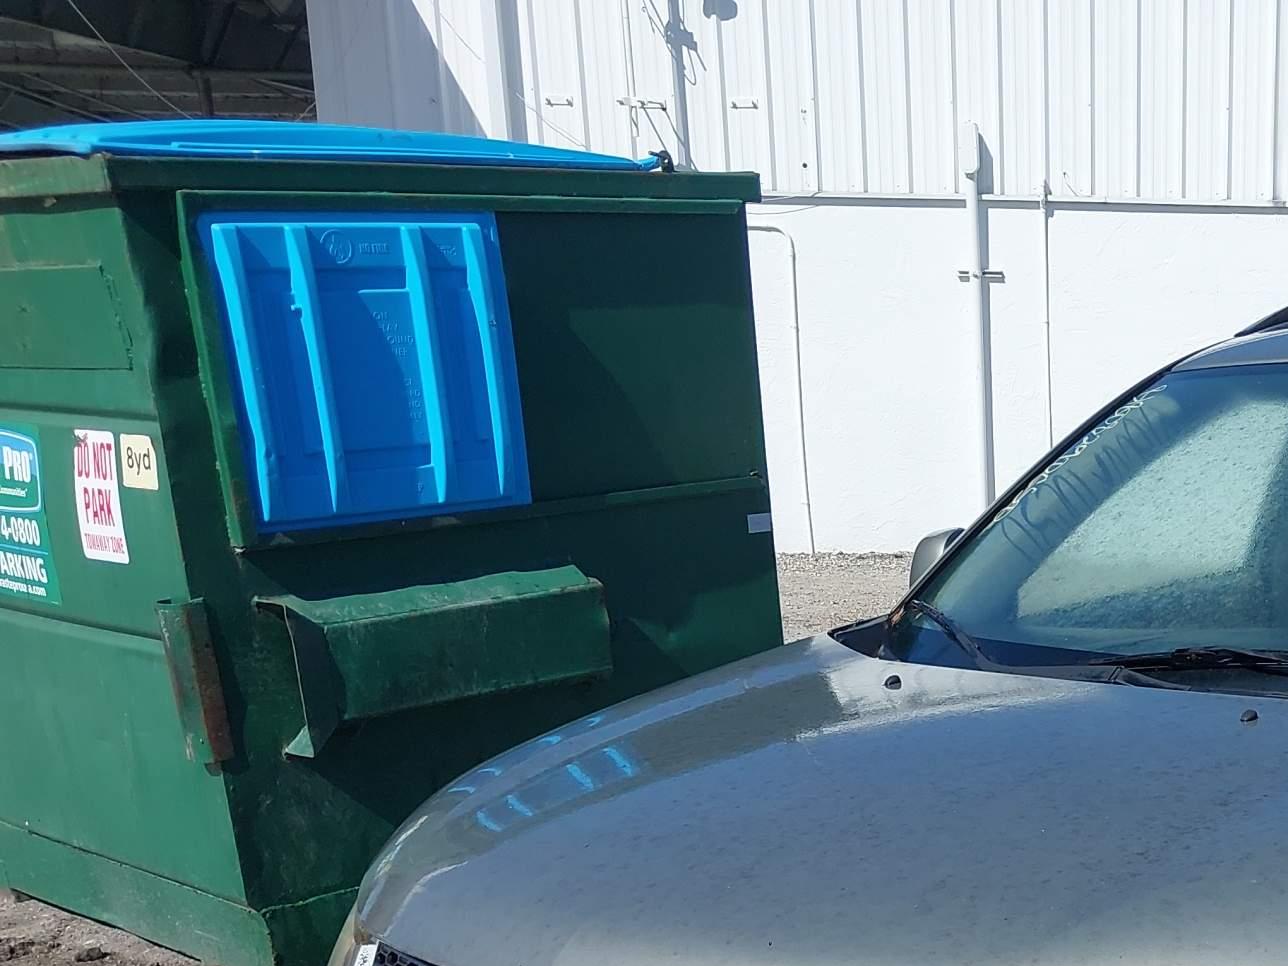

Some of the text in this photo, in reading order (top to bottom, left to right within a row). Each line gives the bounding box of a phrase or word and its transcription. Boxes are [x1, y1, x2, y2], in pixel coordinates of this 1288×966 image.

[3, 445, 32, 483] PRO
[77, 441, 113, 480] DO NOT
[126, 447, 151, 475] 8yd
[83, 487, 115, 527] PARK
[0, 515, 41, 547] 4-0800
[0, 551, 48, 584] ARKING
